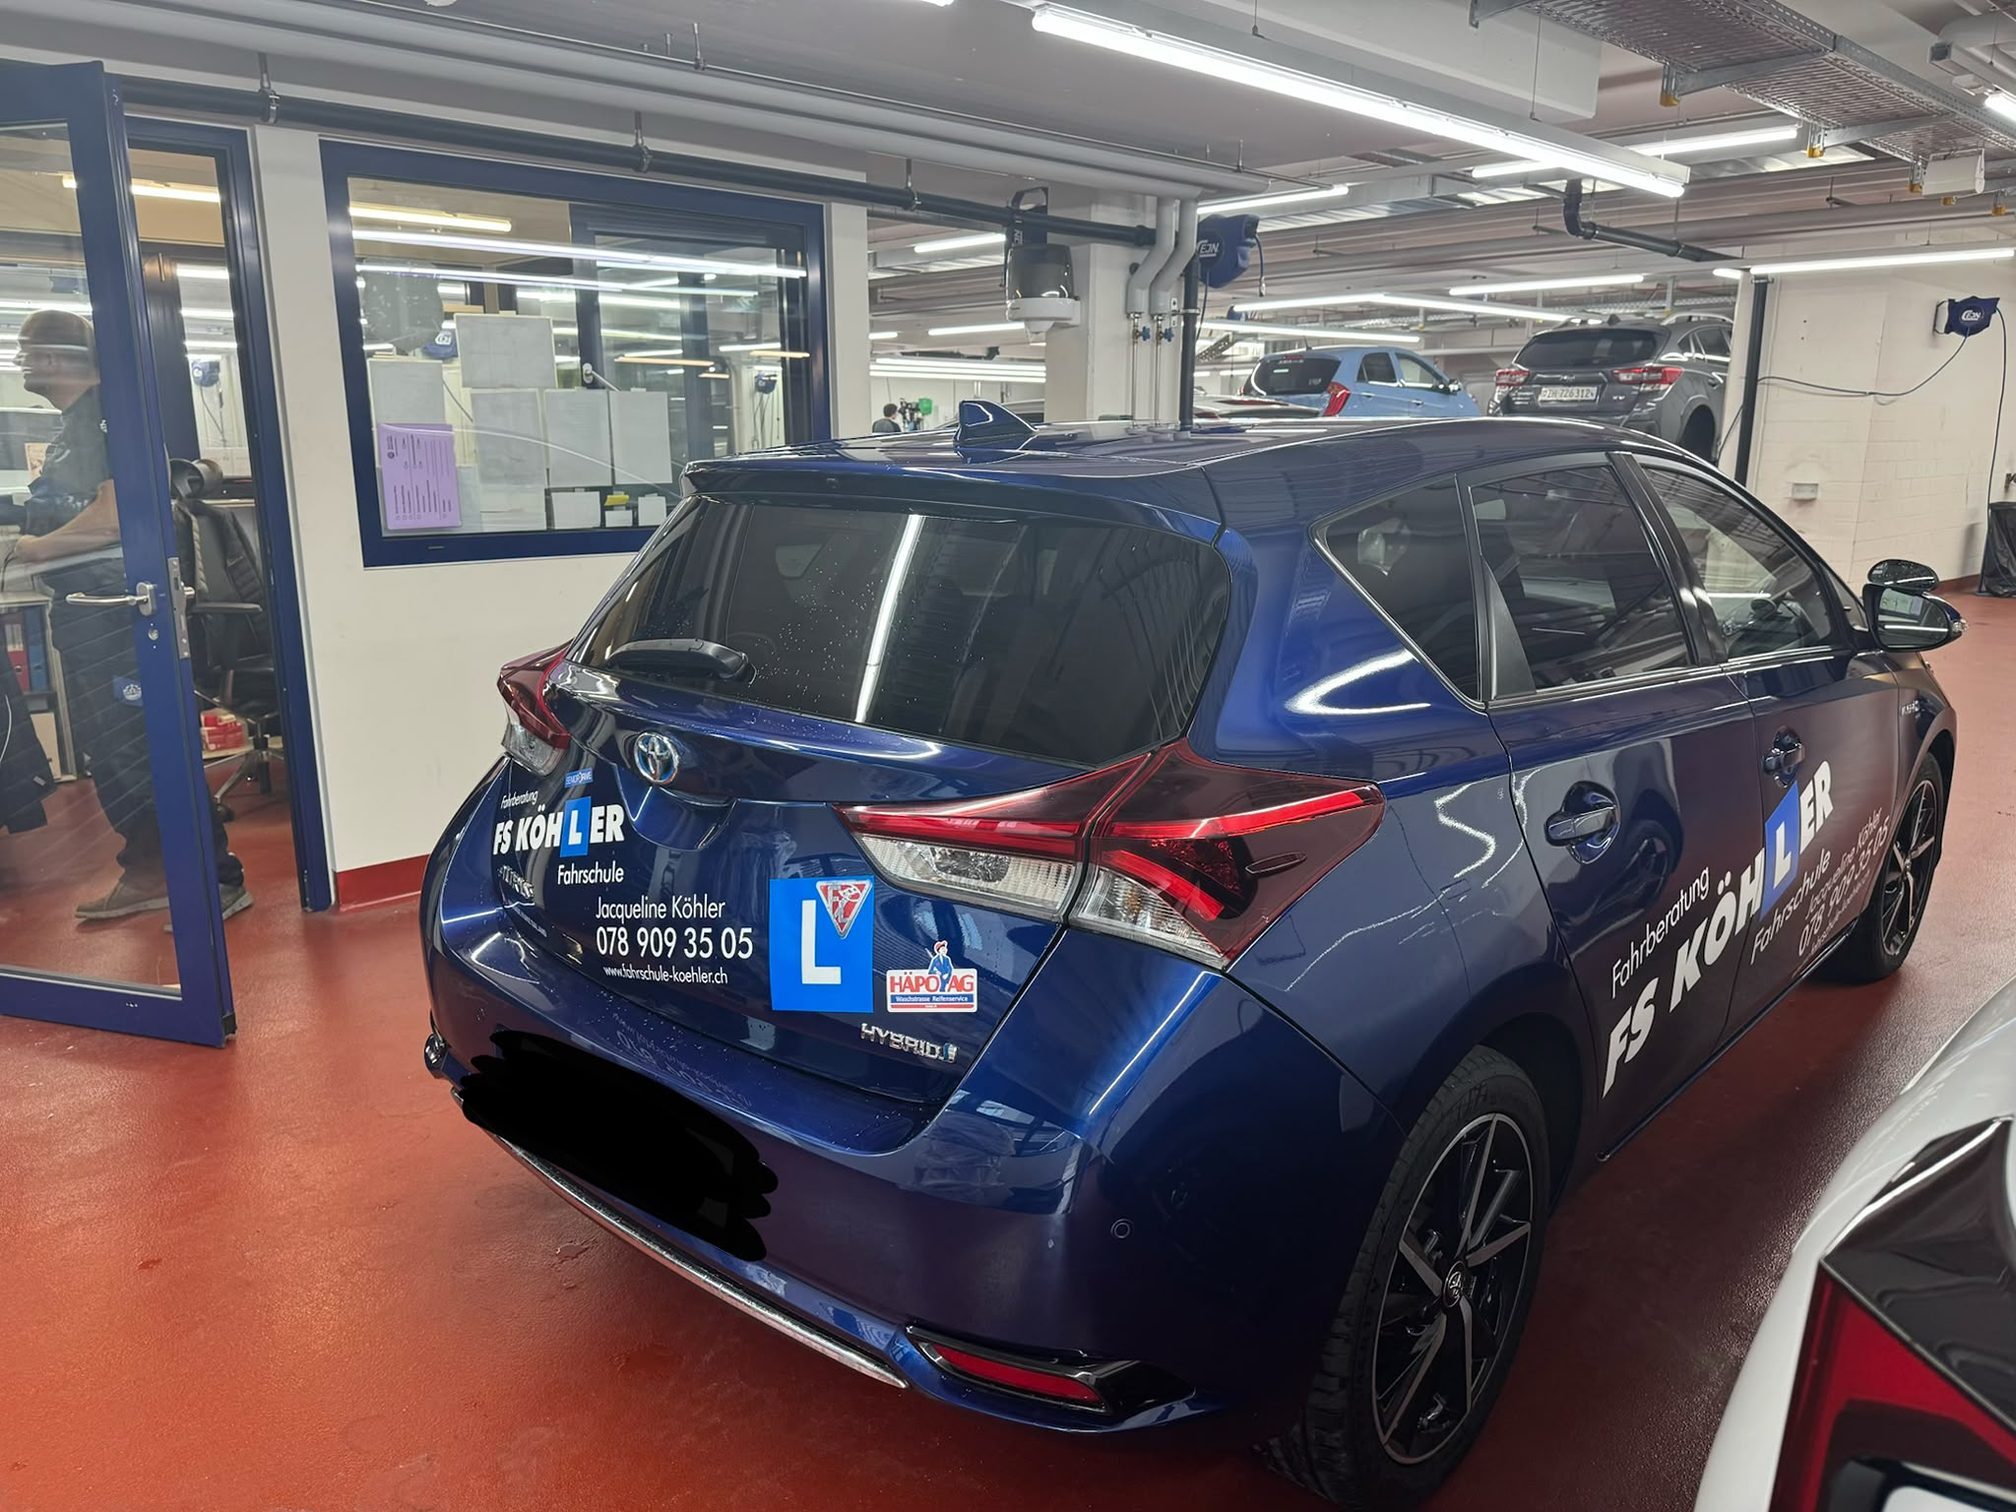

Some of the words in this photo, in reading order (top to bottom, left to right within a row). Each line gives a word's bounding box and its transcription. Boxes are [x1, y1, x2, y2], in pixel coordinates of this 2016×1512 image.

[492, 819, 514, 856] FS
[514, 803, 625, 852] KÖHLER
[557, 859, 625, 886] Fahrschule
[1798, 904, 1826, 957] 078
[1872, 815, 1890, 857] 05
[595, 894, 667, 925] Jacqueline
[671, 892, 726, 919] Köhler
[1750, 847, 1832, 966] Fahrschule
[596, 926, 629, 957] 078
[636, 926, 677, 958] 909
[683, 926, 714, 959] 35
[720, 926, 754, 960] 05
[801, 899, 842, 985] L
[1602, 976, 1660, 1100] FS
[1669, 760, 1835, 1014] KÖHLER
[1611, 866, 1710, 1000] Fahrberatung
[602, 962, 729, 985] www.fahrschule-koehler.ch
[889, 971, 940, 993] HÄPO
[947, 974, 975, 993] AG
[860, 1022, 941, 1060] HYBRID
